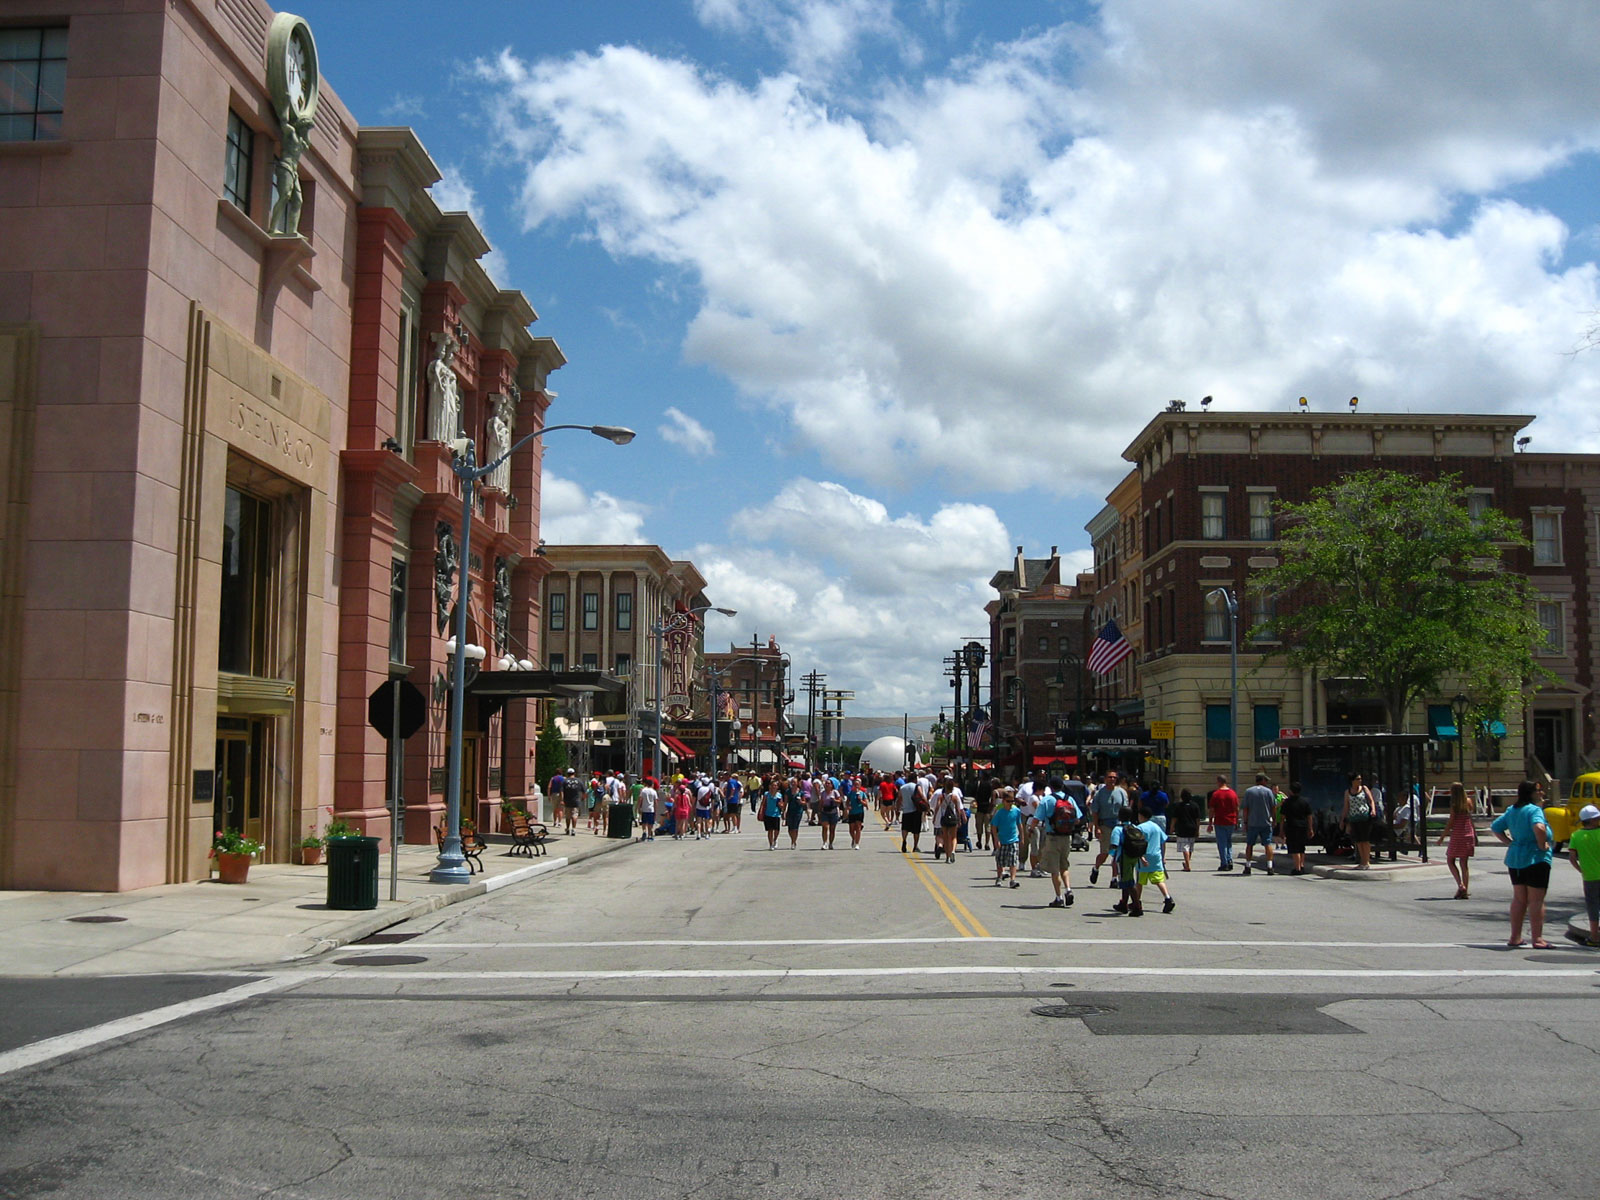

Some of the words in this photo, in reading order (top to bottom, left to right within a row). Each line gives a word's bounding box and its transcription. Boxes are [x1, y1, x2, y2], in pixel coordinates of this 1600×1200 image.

[237, 402, 280, 448] STEIN
[281, 430, 292, 457] &
[295, 438, 314, 469] CO
[673, 633, 682, 694] SAHARA
